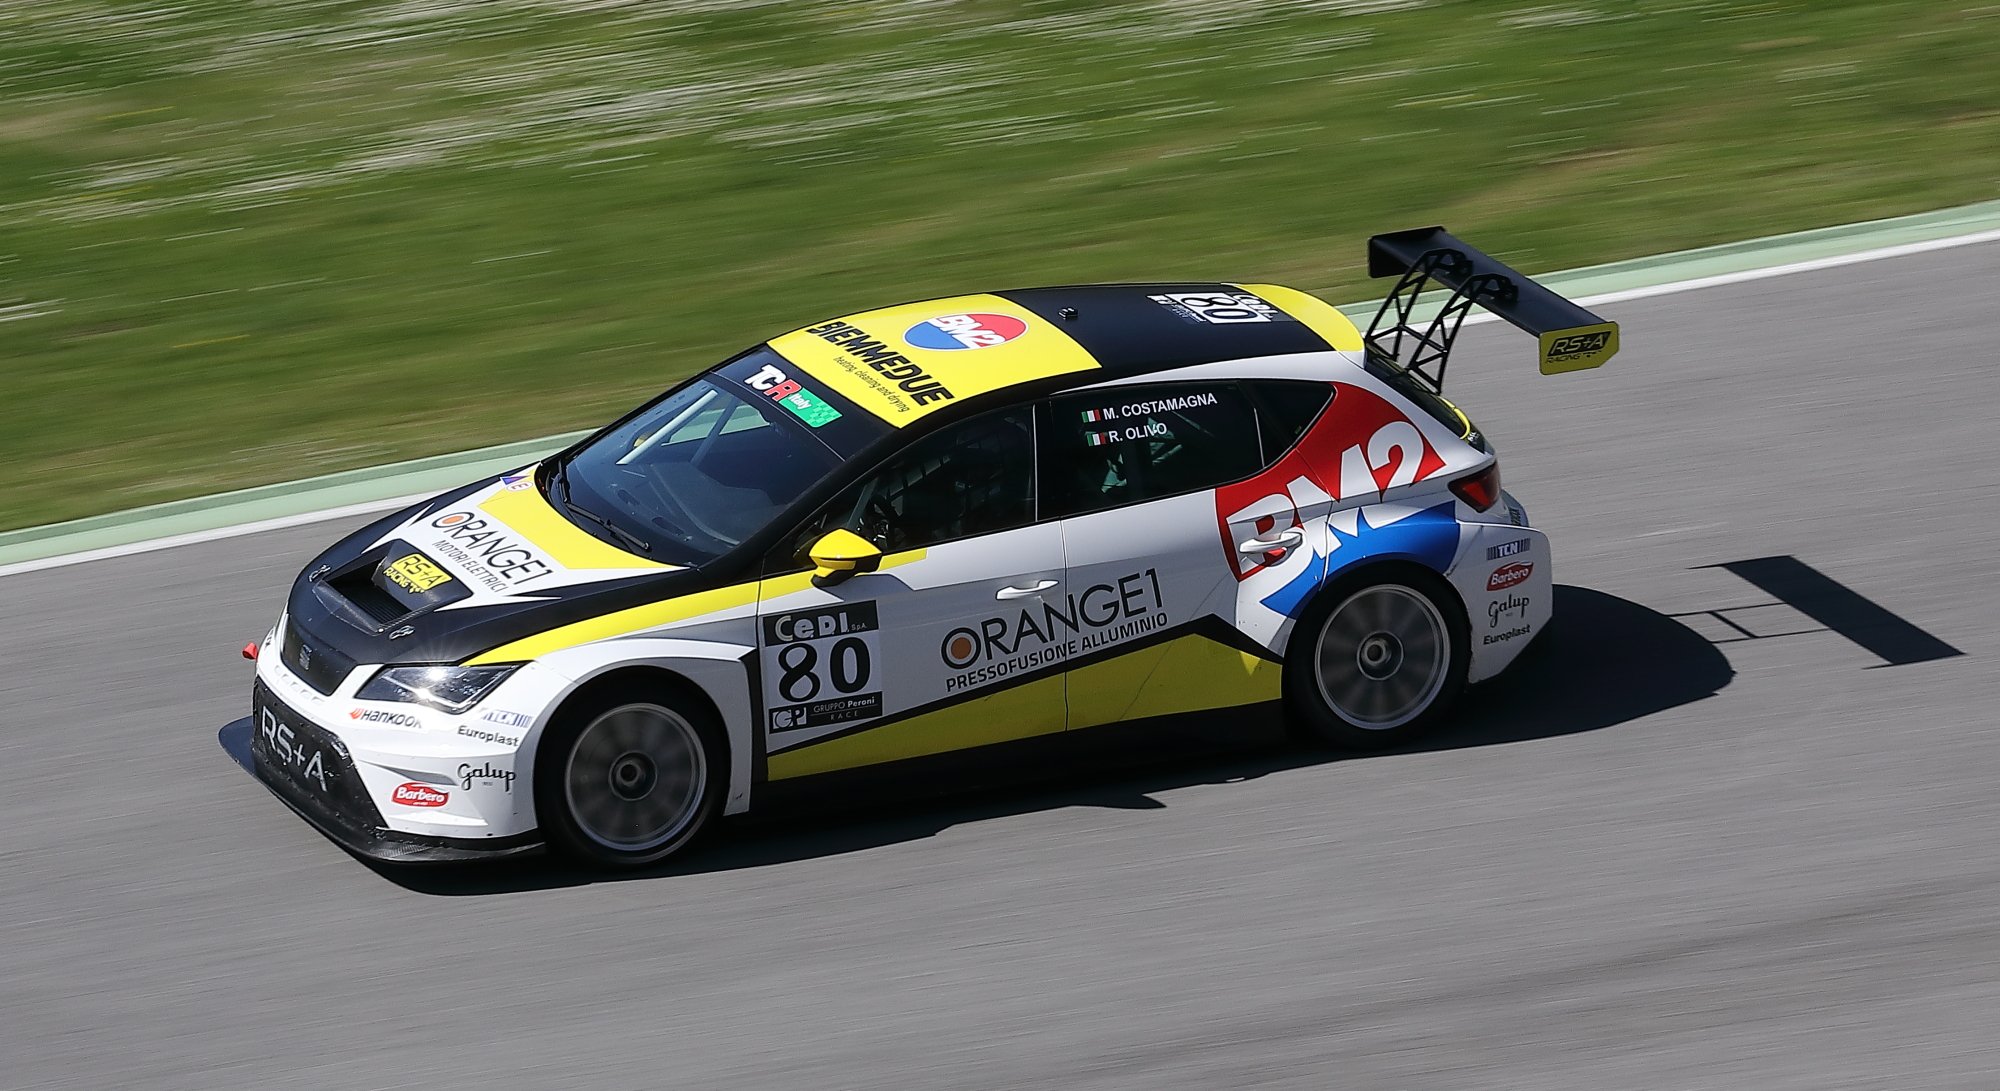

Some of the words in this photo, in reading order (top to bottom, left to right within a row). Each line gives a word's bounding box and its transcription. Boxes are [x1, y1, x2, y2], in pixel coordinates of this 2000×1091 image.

[1180, 297, 1258, 319] 80
[927, 314, 1006, 350] BM2
[1550, 334, 1604, 354] RS+A
[805, 321, 955, 406] BIEMMEDUE
[744, 364, 802, 402] TCR
[787, 393, 812, 410] Italy
[1103, 407, 1119, 420] M.
[1121, 393, 1217, 416] COSTAMAGNA
[1108, 430, 1123, 443] R.
[1125, 422, 1167, 440] OLIVO
[1226, 420, 1432, 577] BM2
[431, 511, 553, 585] ORANGE1
[1498, 541, 1519, 557] TCN
[383, 567, 411, 588] RACING
[397, 556, 446, 587] RS+A
[432, 540, 471, 564] MOTORI
[461, 557, 509, 593] ELETTRICI
[1490, 567, 1529, 586] Barbero
[941, 568, 1163, 670] ORANGE1
[1488, 593, 1530, 628] Galup
[1483, 624, 1531, 645] Europlast
[946, 639, 1078, 692] PRESSOFUSIONE
[1081, 612, 1168, 652] ALLUMINIO
[777, 636, 871, 703] 80
[814, 702, 846, 713] GRUPPO
[847, 696, 875, 708] Peroni
[830, 710, 858, 721] RACE
[261, 705, 328, 792] RS+A
[457, 725, 519, 747] Europlast
[457, 762, 517, 792] Galup
[397, 786, 445, 803] Barbero
